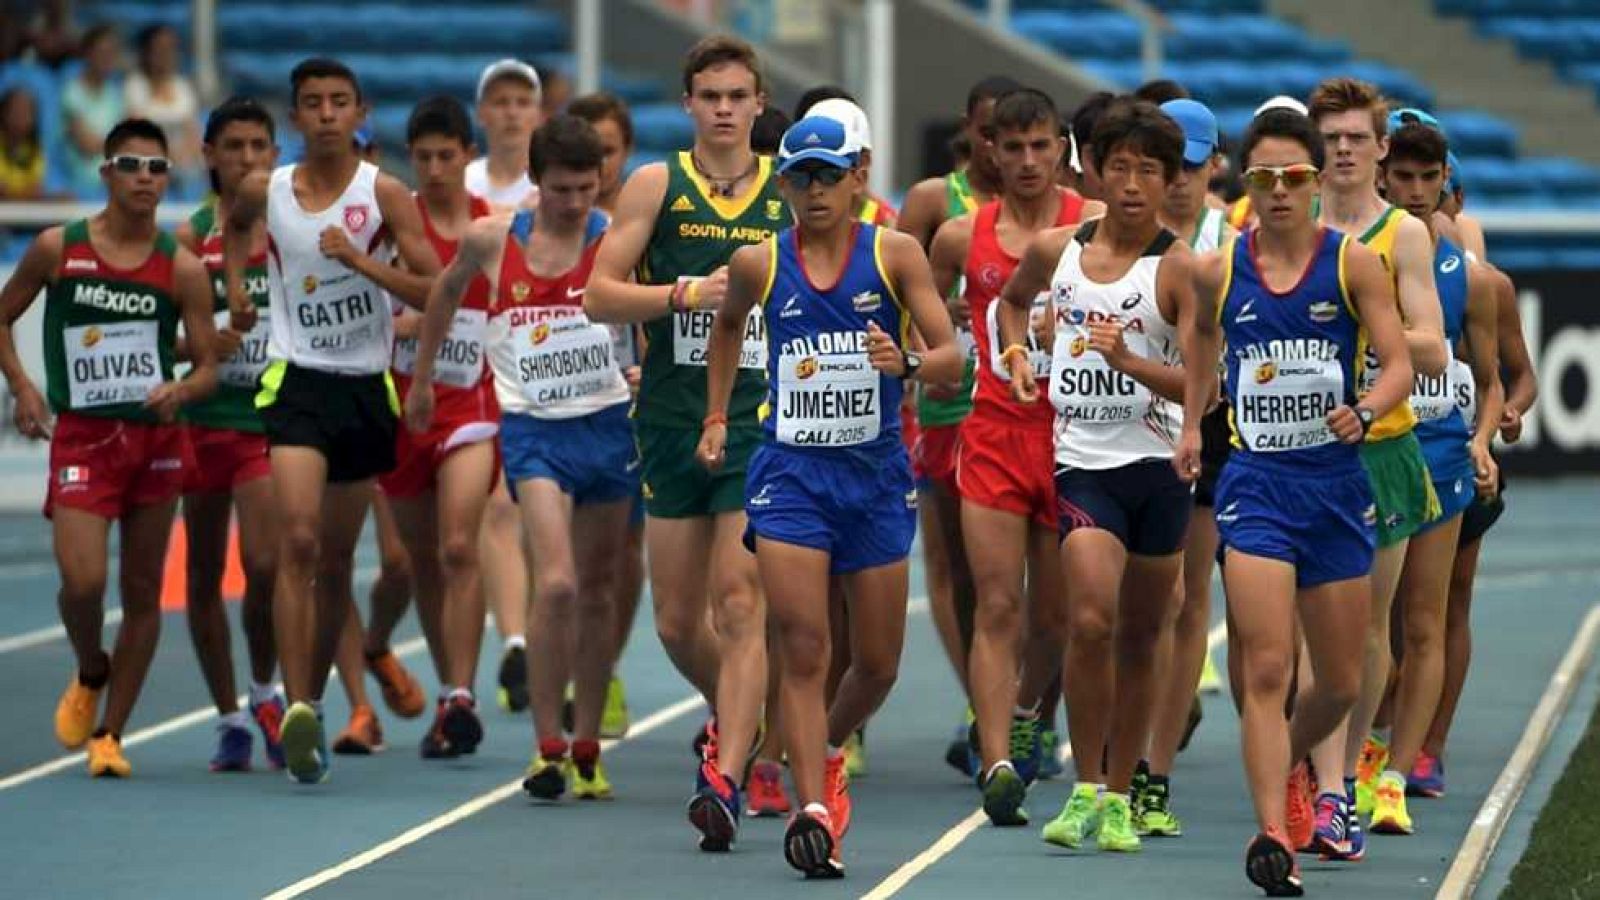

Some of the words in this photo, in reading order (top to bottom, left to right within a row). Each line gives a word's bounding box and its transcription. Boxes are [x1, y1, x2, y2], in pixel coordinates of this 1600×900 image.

[679, 223, 726, 239] SOUTH
[74, 284, 157, 315] MÉXICO
[298, 291, 373, 328] GATRI
[311, 335, 342, 349] CALI
[74, 352, 155, 383] OLIVAS
[518, 342, 610, 382] SHIROBOKOV
[537, 387, 572, 403] CALI
[1059, 368, 1136, 397] SONG
[783, 383, 875, 419] JIMÉNEZ
[1064, 406, 1098, 420] CALI
[1101, 405, 1133, 420] 2015
[1243, 391, 1336, 424] HERRERA
[794, 429, 832, 444] CALI
[835, 426, 867, 443] 2015
[1255, 434, 1294, 449] CALI
[1297, 428, 1328, 447] 2015
